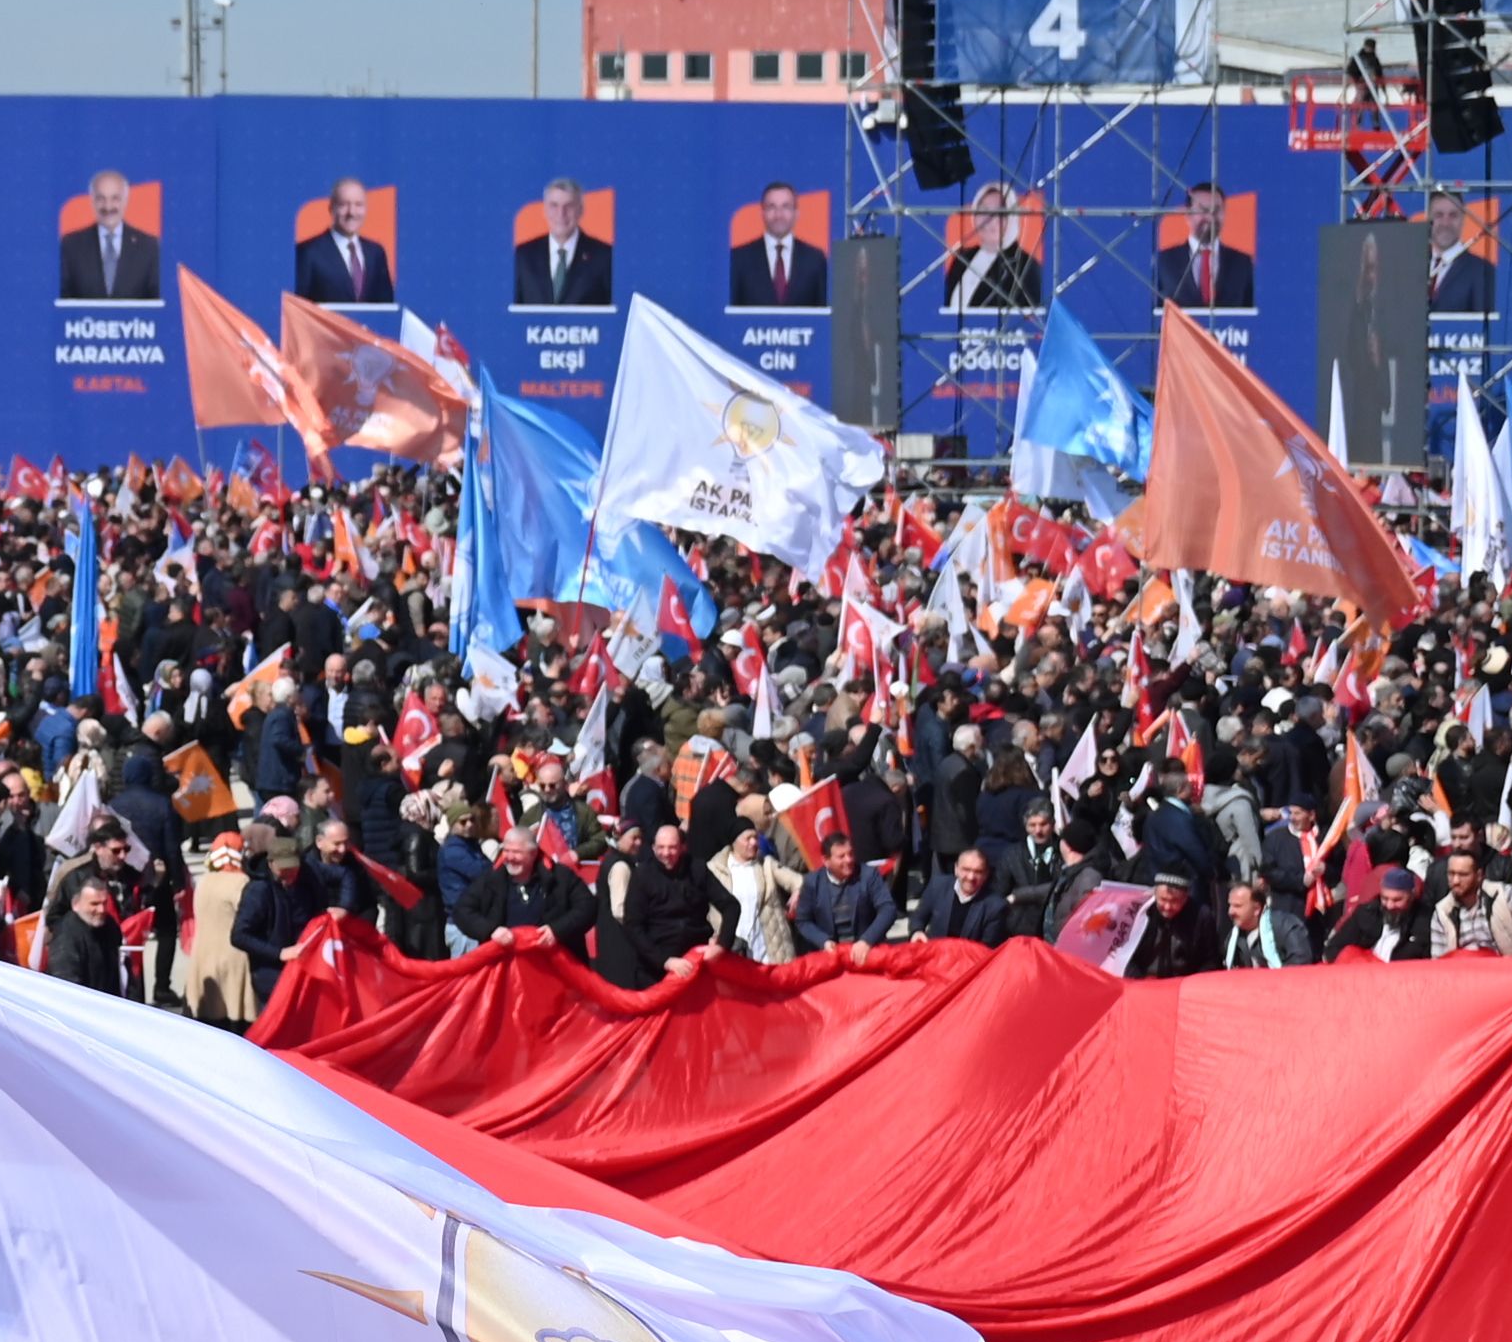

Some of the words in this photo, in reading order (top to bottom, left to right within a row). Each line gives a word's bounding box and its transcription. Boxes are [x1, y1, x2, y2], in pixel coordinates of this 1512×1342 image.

[64, 316, 155, 340] HÜSEYİN
[526, 326, 600, 345] KADEM
[742, 327, 814, 346] AHMET
[55, 345, 165, 364] KARAKAYA
[539, 347, 586, 374] EKŞİ
[520, 380, 605, 398] MALTEPE
